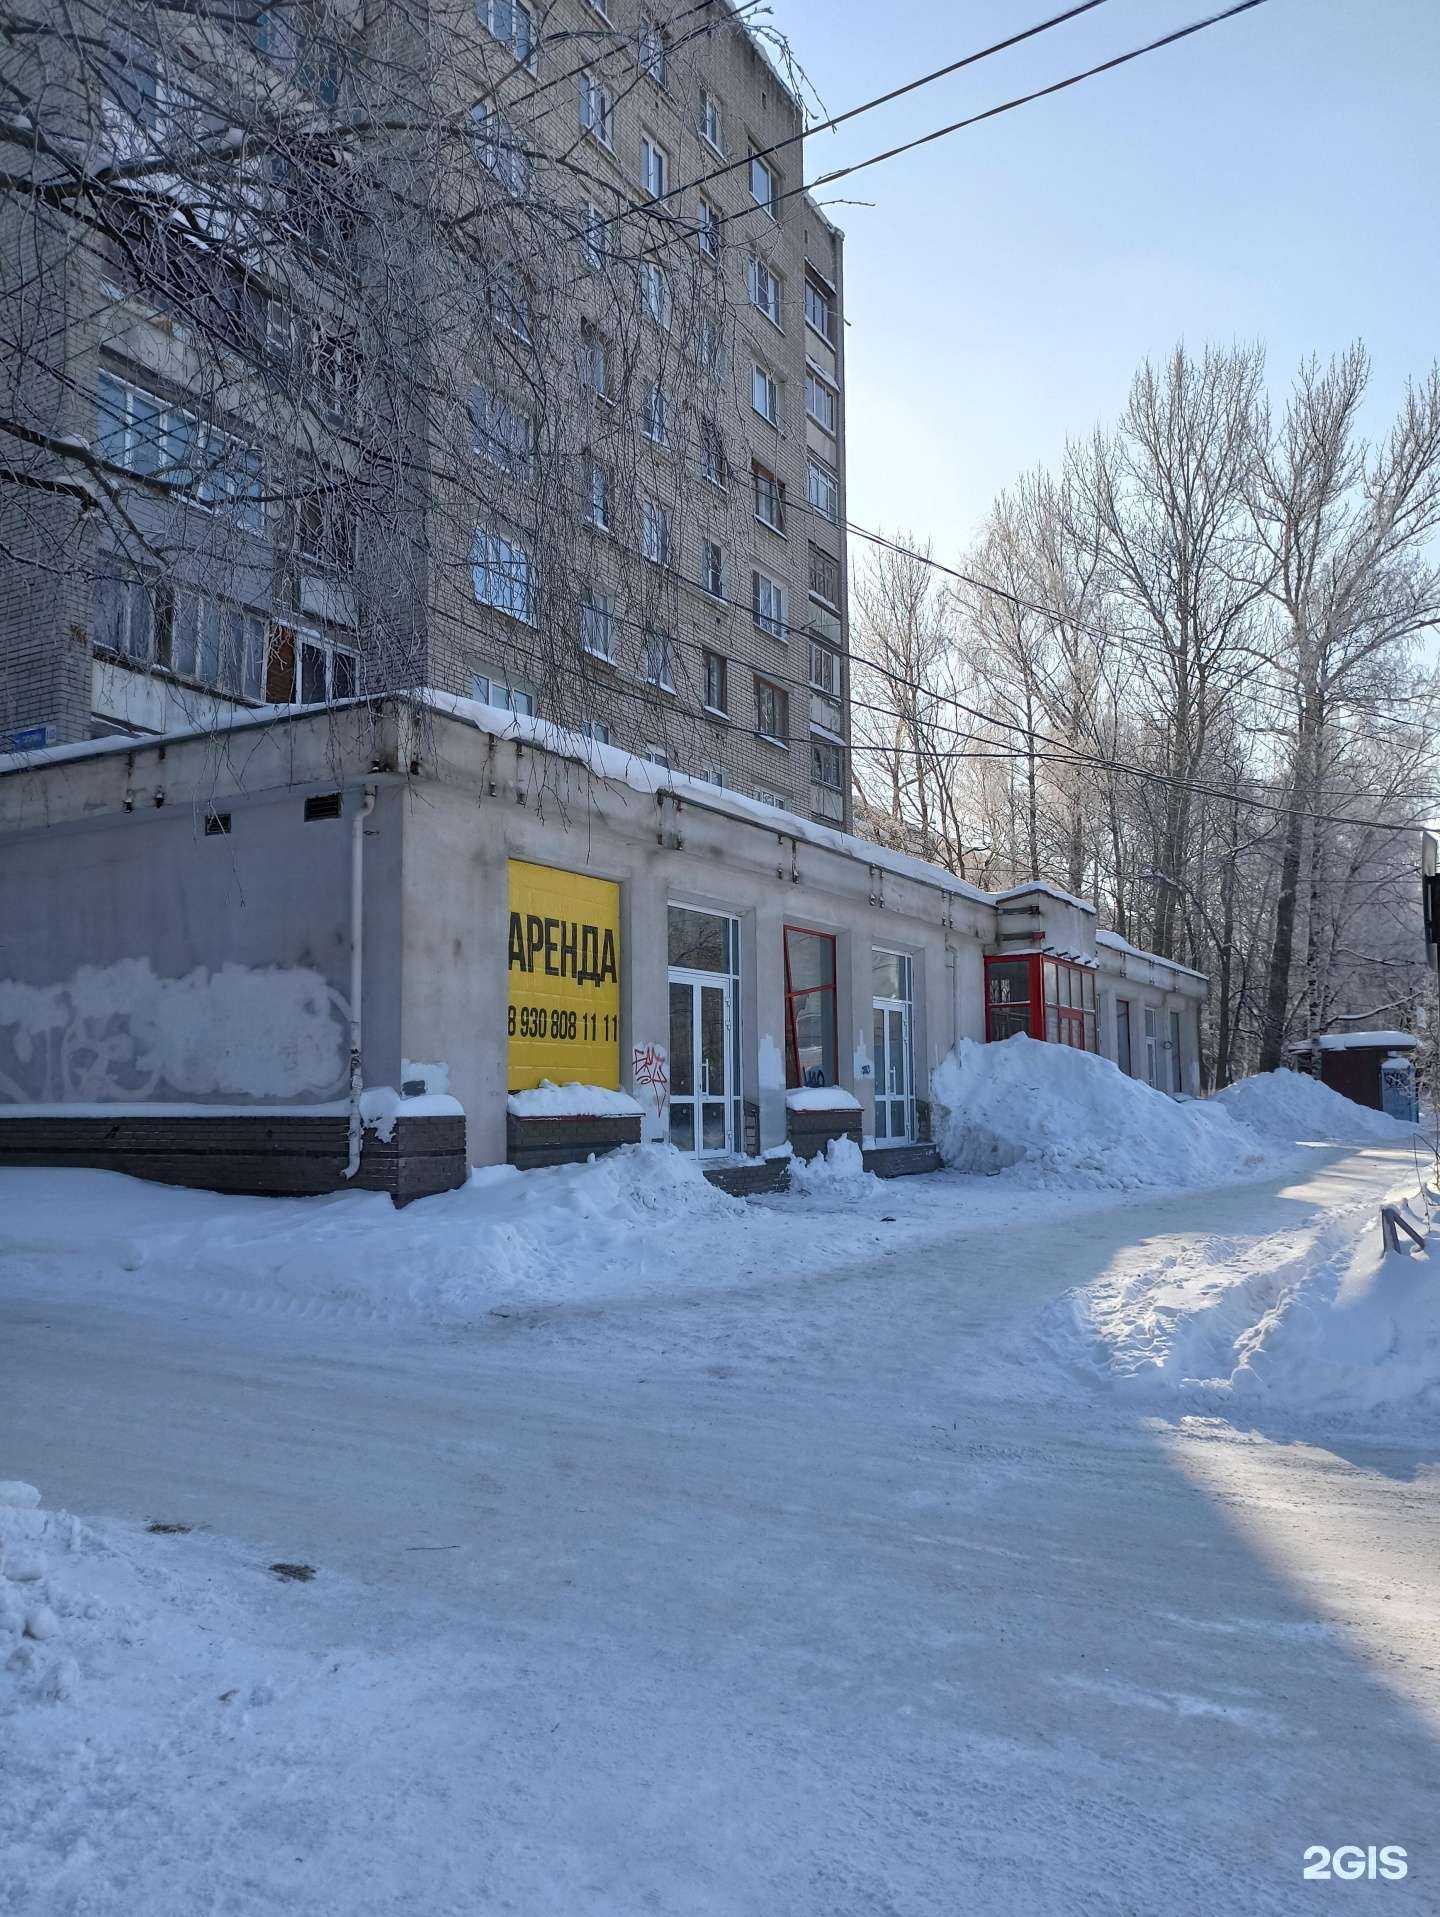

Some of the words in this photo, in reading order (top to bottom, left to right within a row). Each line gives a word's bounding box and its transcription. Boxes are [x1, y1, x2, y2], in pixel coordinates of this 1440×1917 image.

[508, 911, 618, 988] АРЕНДА
[507, 1005, 517, 1037] 8
[520, 1006, 547, 1038] 930
[550, 1009, 577, 1040] 808
[583, 1012, 596, 1041] 11
[603, 1014, 618, 1042] 11
